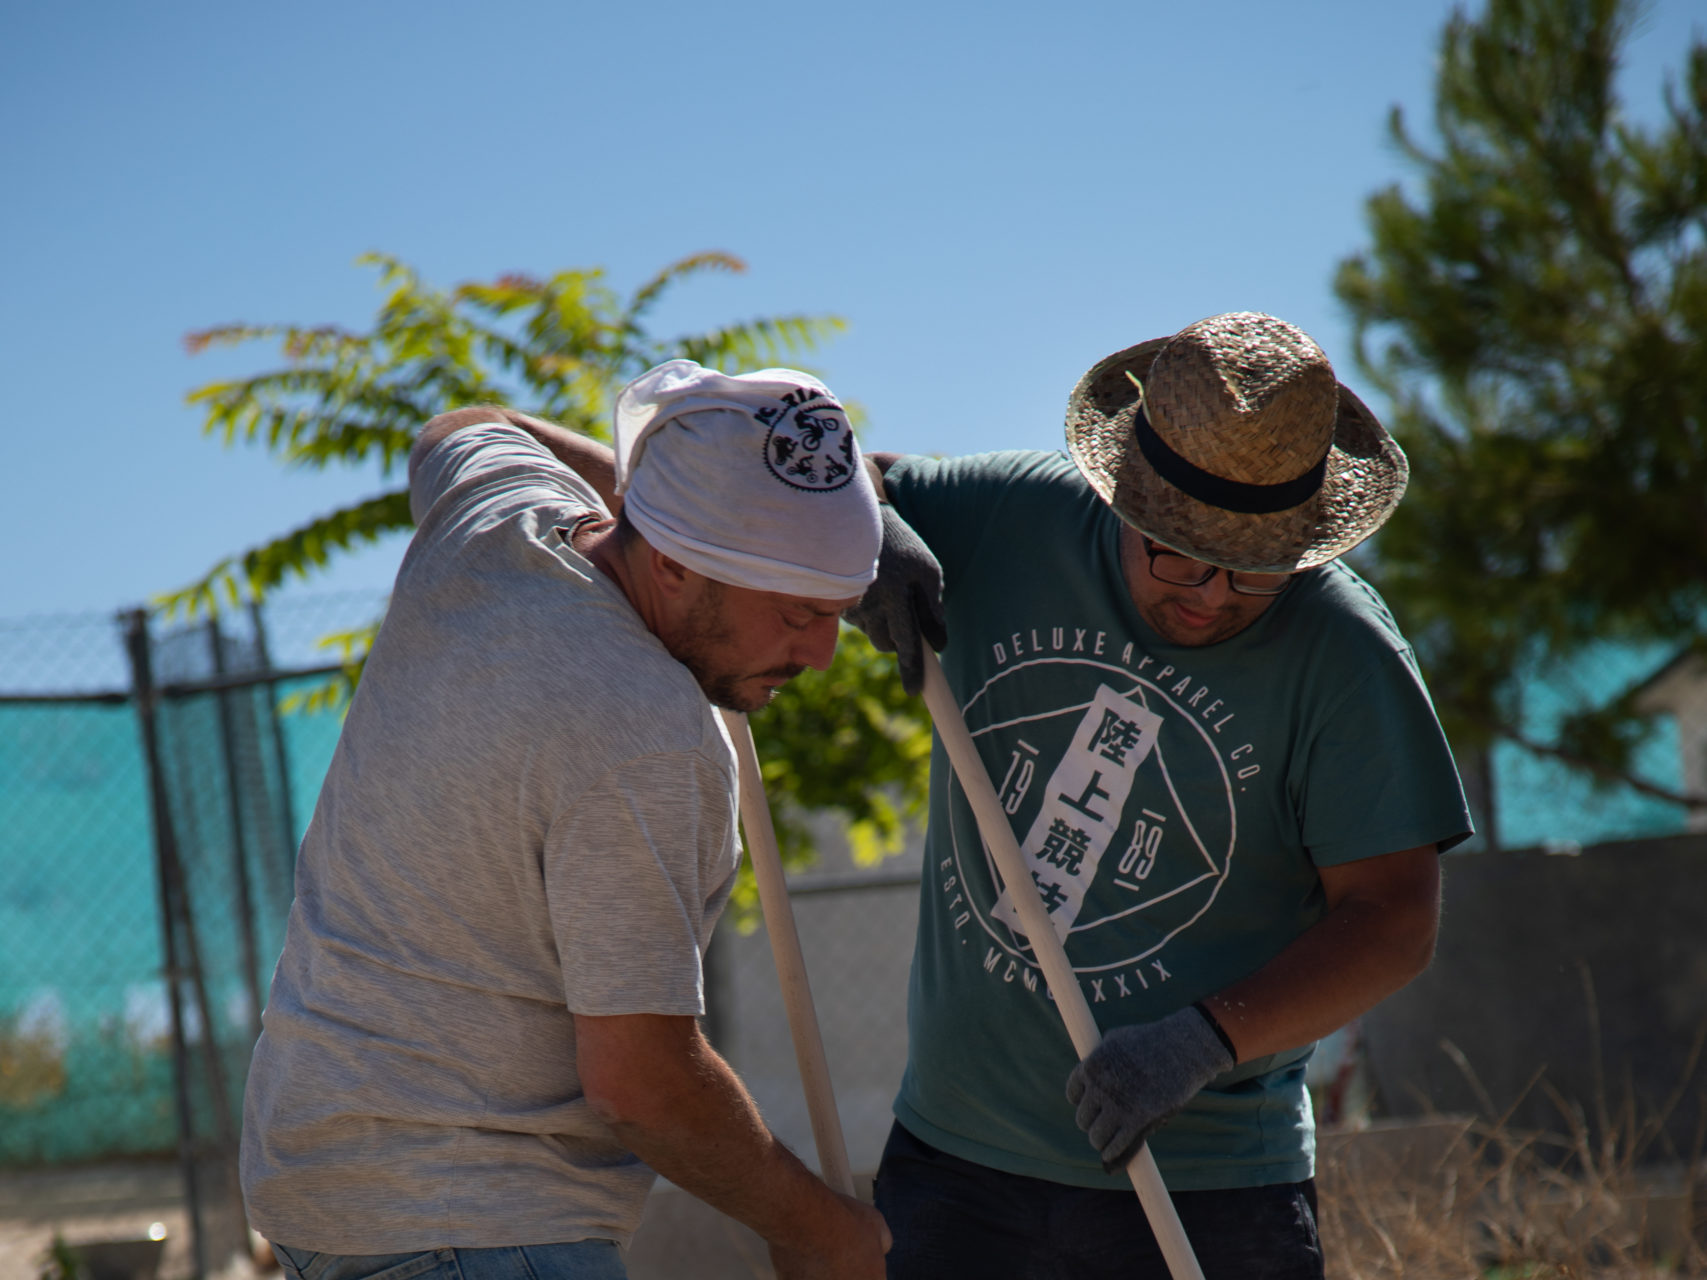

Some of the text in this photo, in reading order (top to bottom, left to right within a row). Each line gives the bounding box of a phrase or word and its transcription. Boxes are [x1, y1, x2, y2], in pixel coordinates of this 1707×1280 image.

[993, 627, 1260, 792] DELUXE APPAREL CO.
[999, 751, 1035, 815] 19
[1118, 820, 1163, 880] 89
[940, 856, 1171, 1003] ESTD. MCMXXIX
